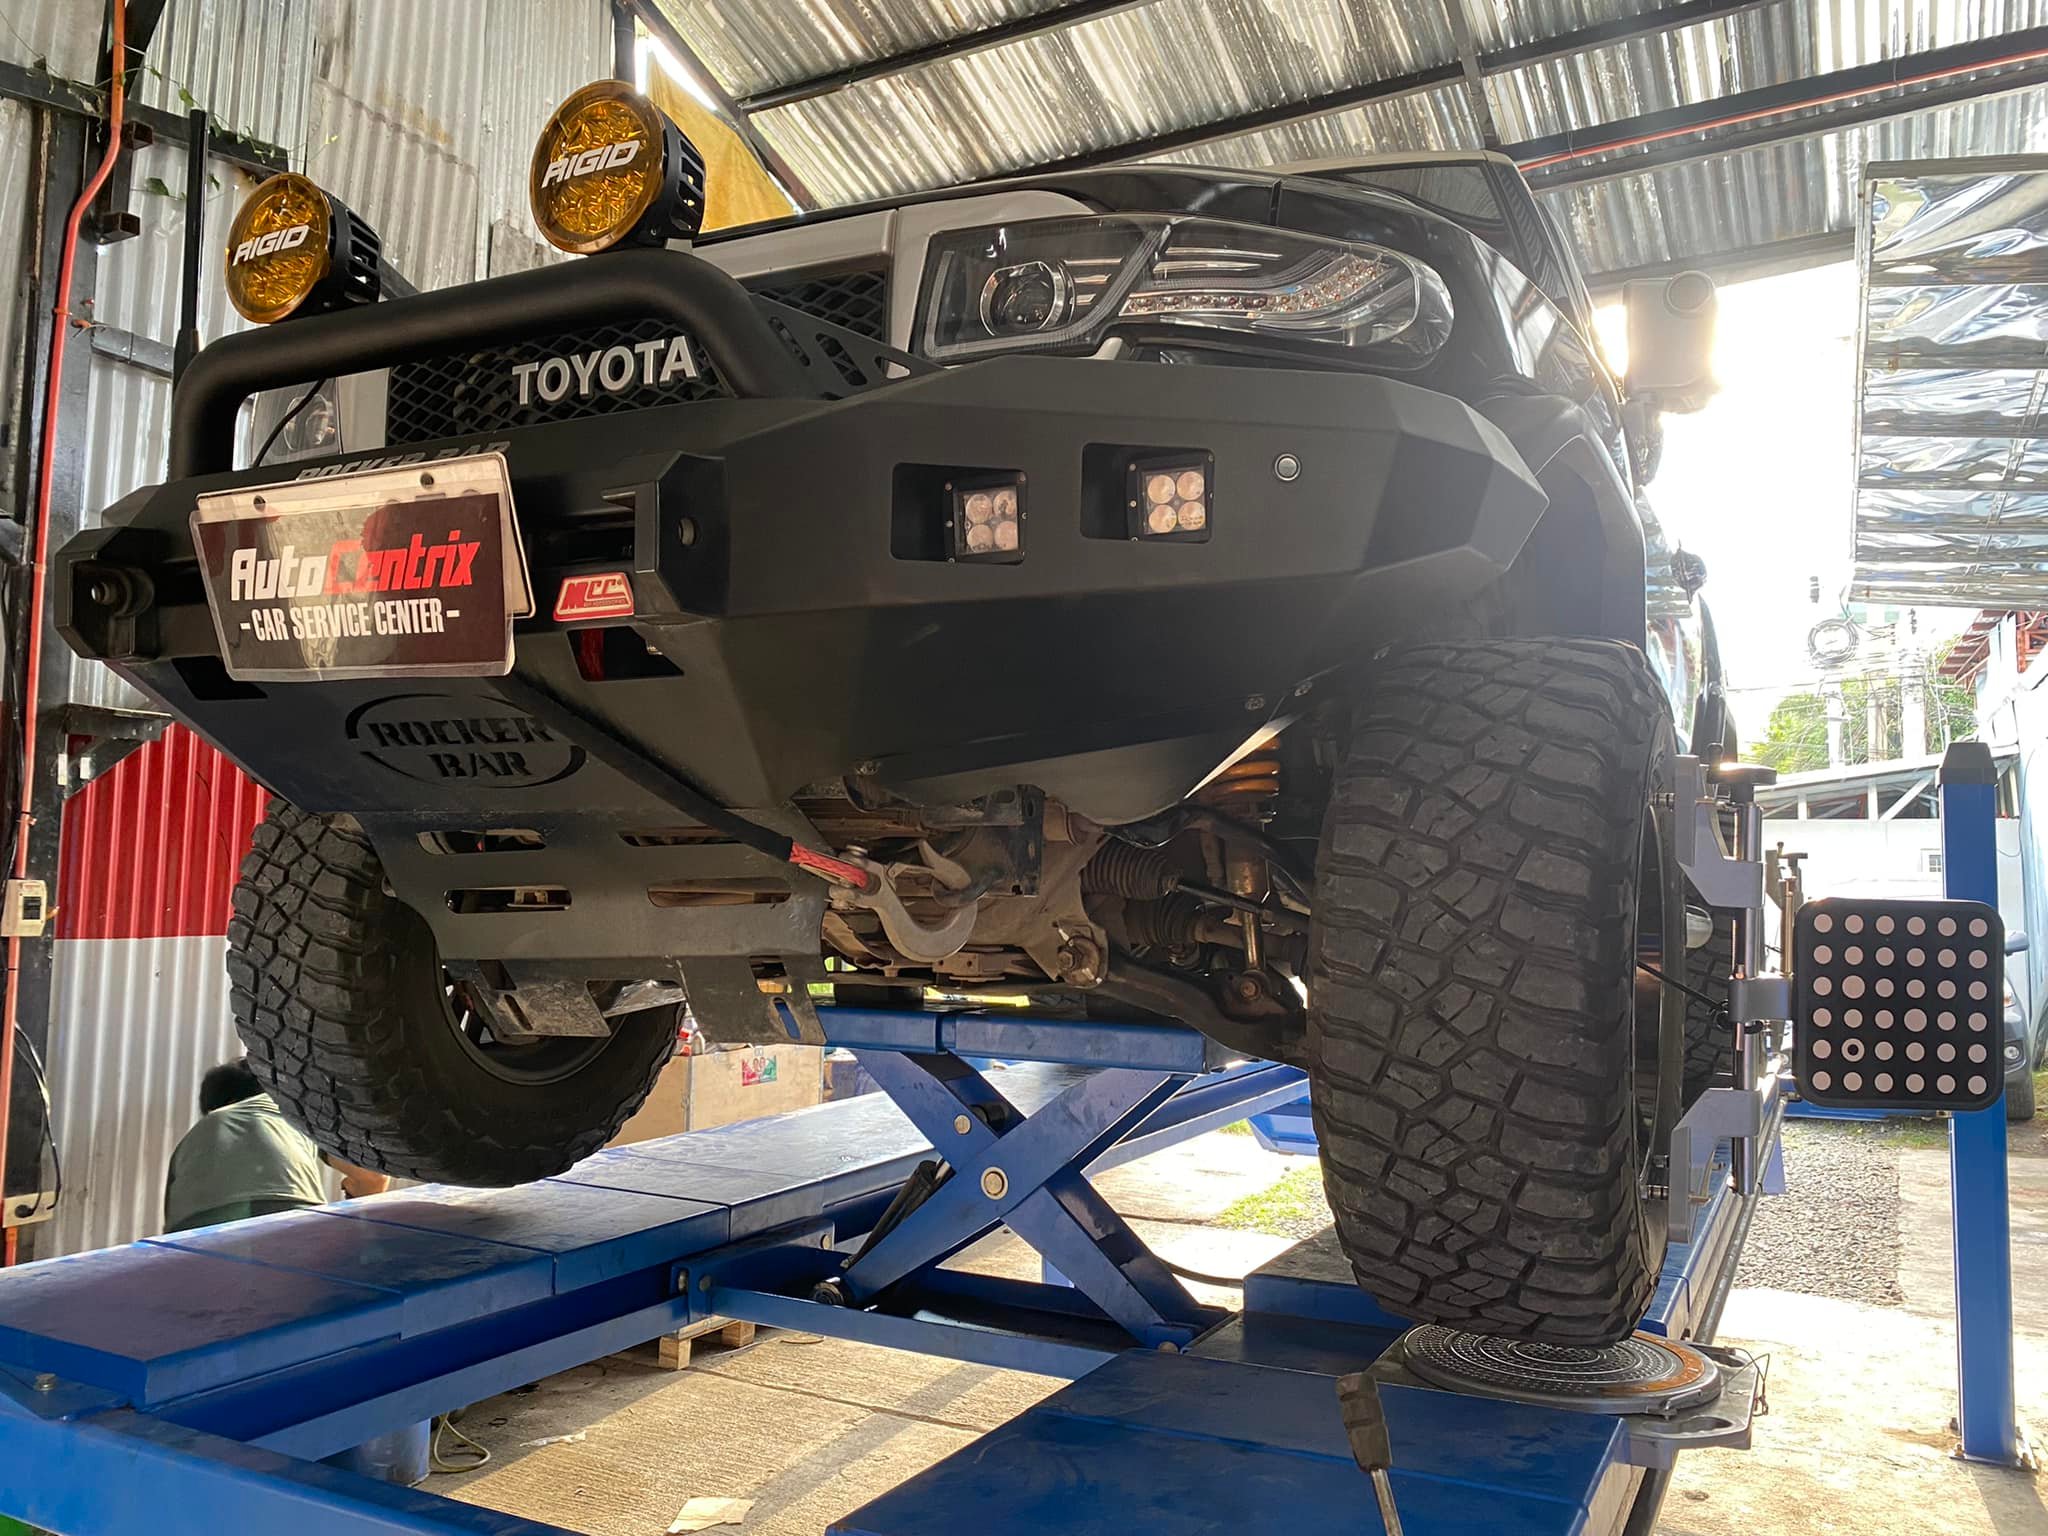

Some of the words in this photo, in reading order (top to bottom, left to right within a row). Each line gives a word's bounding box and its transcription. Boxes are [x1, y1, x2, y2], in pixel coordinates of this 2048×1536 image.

[541, 140, 640, 188] RIGID
[232, 225, 309, 267] RIGID
[511, 335, 698, 406] TOYOTA
[231, 529, 481, 601] AutoCentrix
[290, 602, 372, 641] SERVICE
[366, 716, 555, 748] ROCKER
[426, 751, 533, 779] BAR
